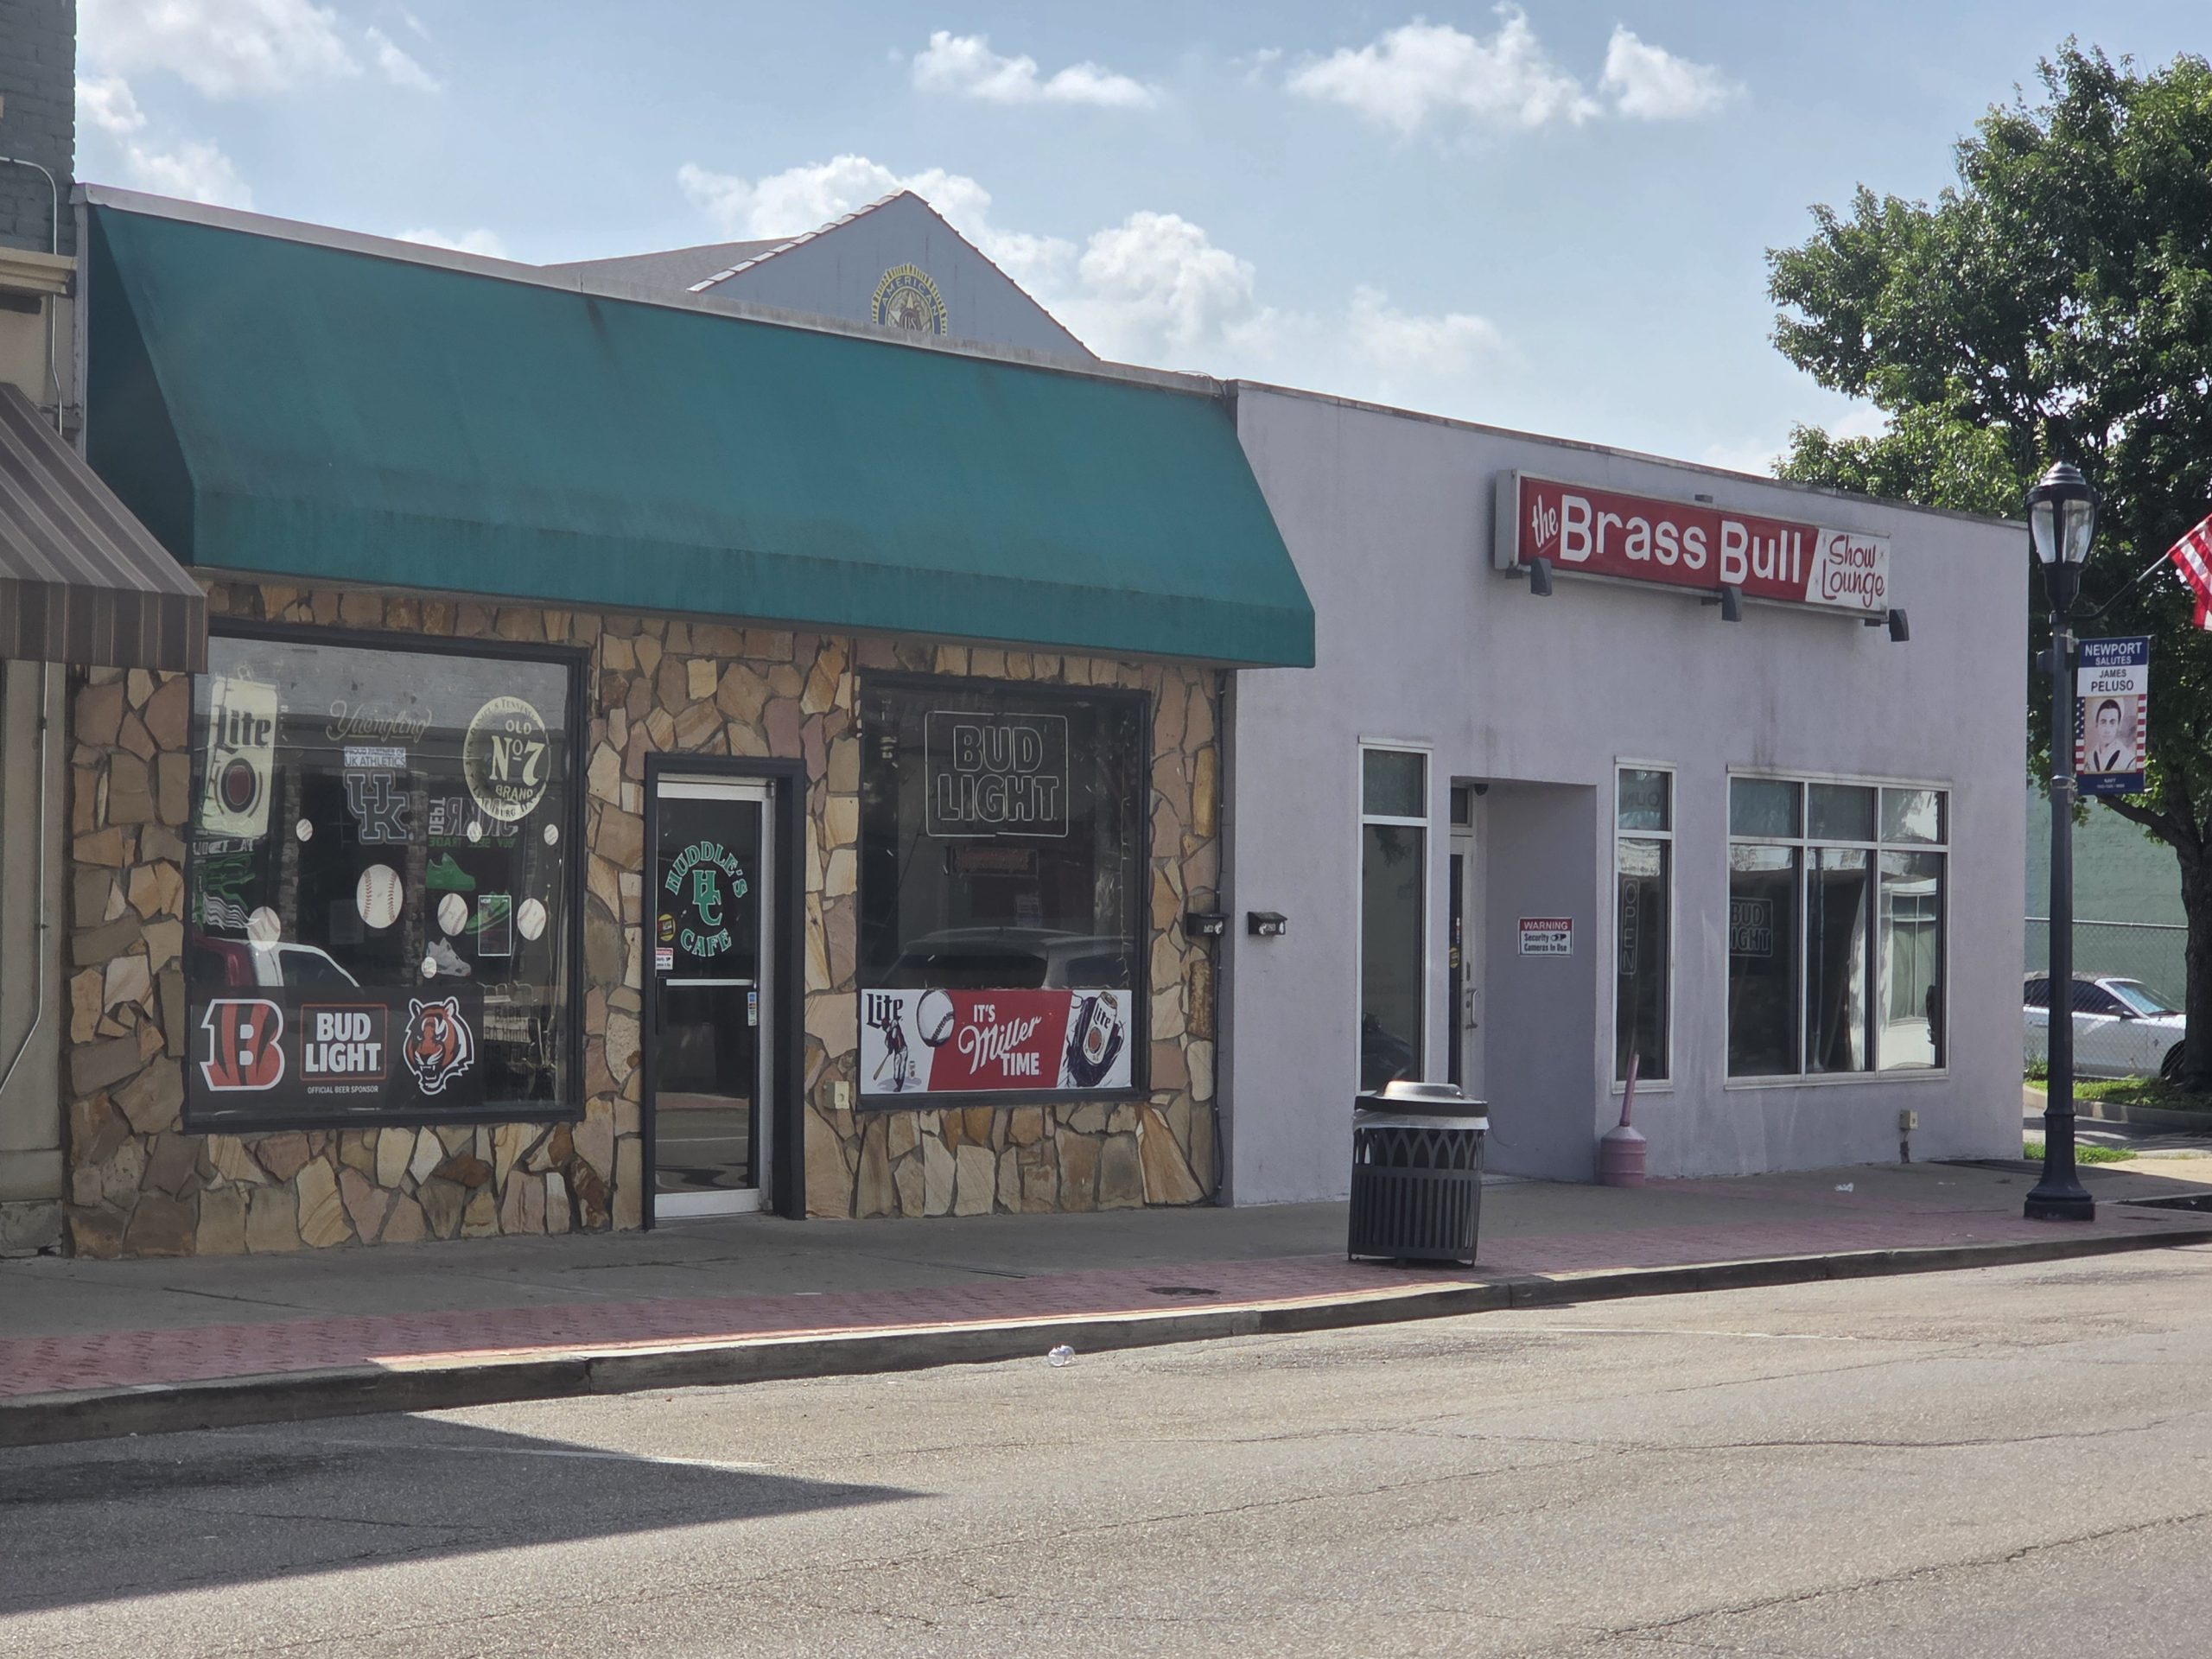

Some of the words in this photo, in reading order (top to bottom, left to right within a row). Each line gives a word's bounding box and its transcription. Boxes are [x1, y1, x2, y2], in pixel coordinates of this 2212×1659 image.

[881, 276, 938, 316] AMERICAN
[1532, 494, 1559, 550] the
[1560, 494, 1707, 570] Brass
[1720, 520, 1801, 585] Bull
[1828, 535, 1877, 569] Show
[1821, 559, 1885, 608] Lounge
[2085, 642, 2143, 657] NEWPORT
[2095, 656, 2132, 666] SALUTES
[2091, 680, 2133, 692] PELUSO
[2099, 669, 2126, 678] JAMES
[213, 705, 271, 754] Lite
[326, 700, 432, 743] Yuengling
[505, 720, 531, 734] OLD
[346, 756, 358, 766] UK
[359, 756, 406, 767] ATHLETICS
[523, 740, 545, 786] 7
[953, 725, 1042, 772] BUD
[346, 773, 407, 842] UK
[495, 785, 533, 802] BRAND
[938, 774, 1059, 822] LIGHT
[664, 841, 748, 898] HUDDLE'S
[1523, 921, 1568, 930] WARNING
[1624, 883, 1637, 969] OPEN
[1731, 902, 1764, 925] BUD
[680, 928, 733, 957] CAFE
[1524, 933, 1549, 943] Security
[1730, 927, 1770, 951] IGHT
[866, 993, 904, 1029] Lite
[974, 1004, 995, 1023] IT'S
[1093, 1002, 1111, 1030] Lite
[316, 1013, 372, 1042] BUD
[305, 1042, 381, 1073] LIGHT
[957, 1015, 1042, 1075] Miller
[1001, 1052, 1041, 1077] TIME
